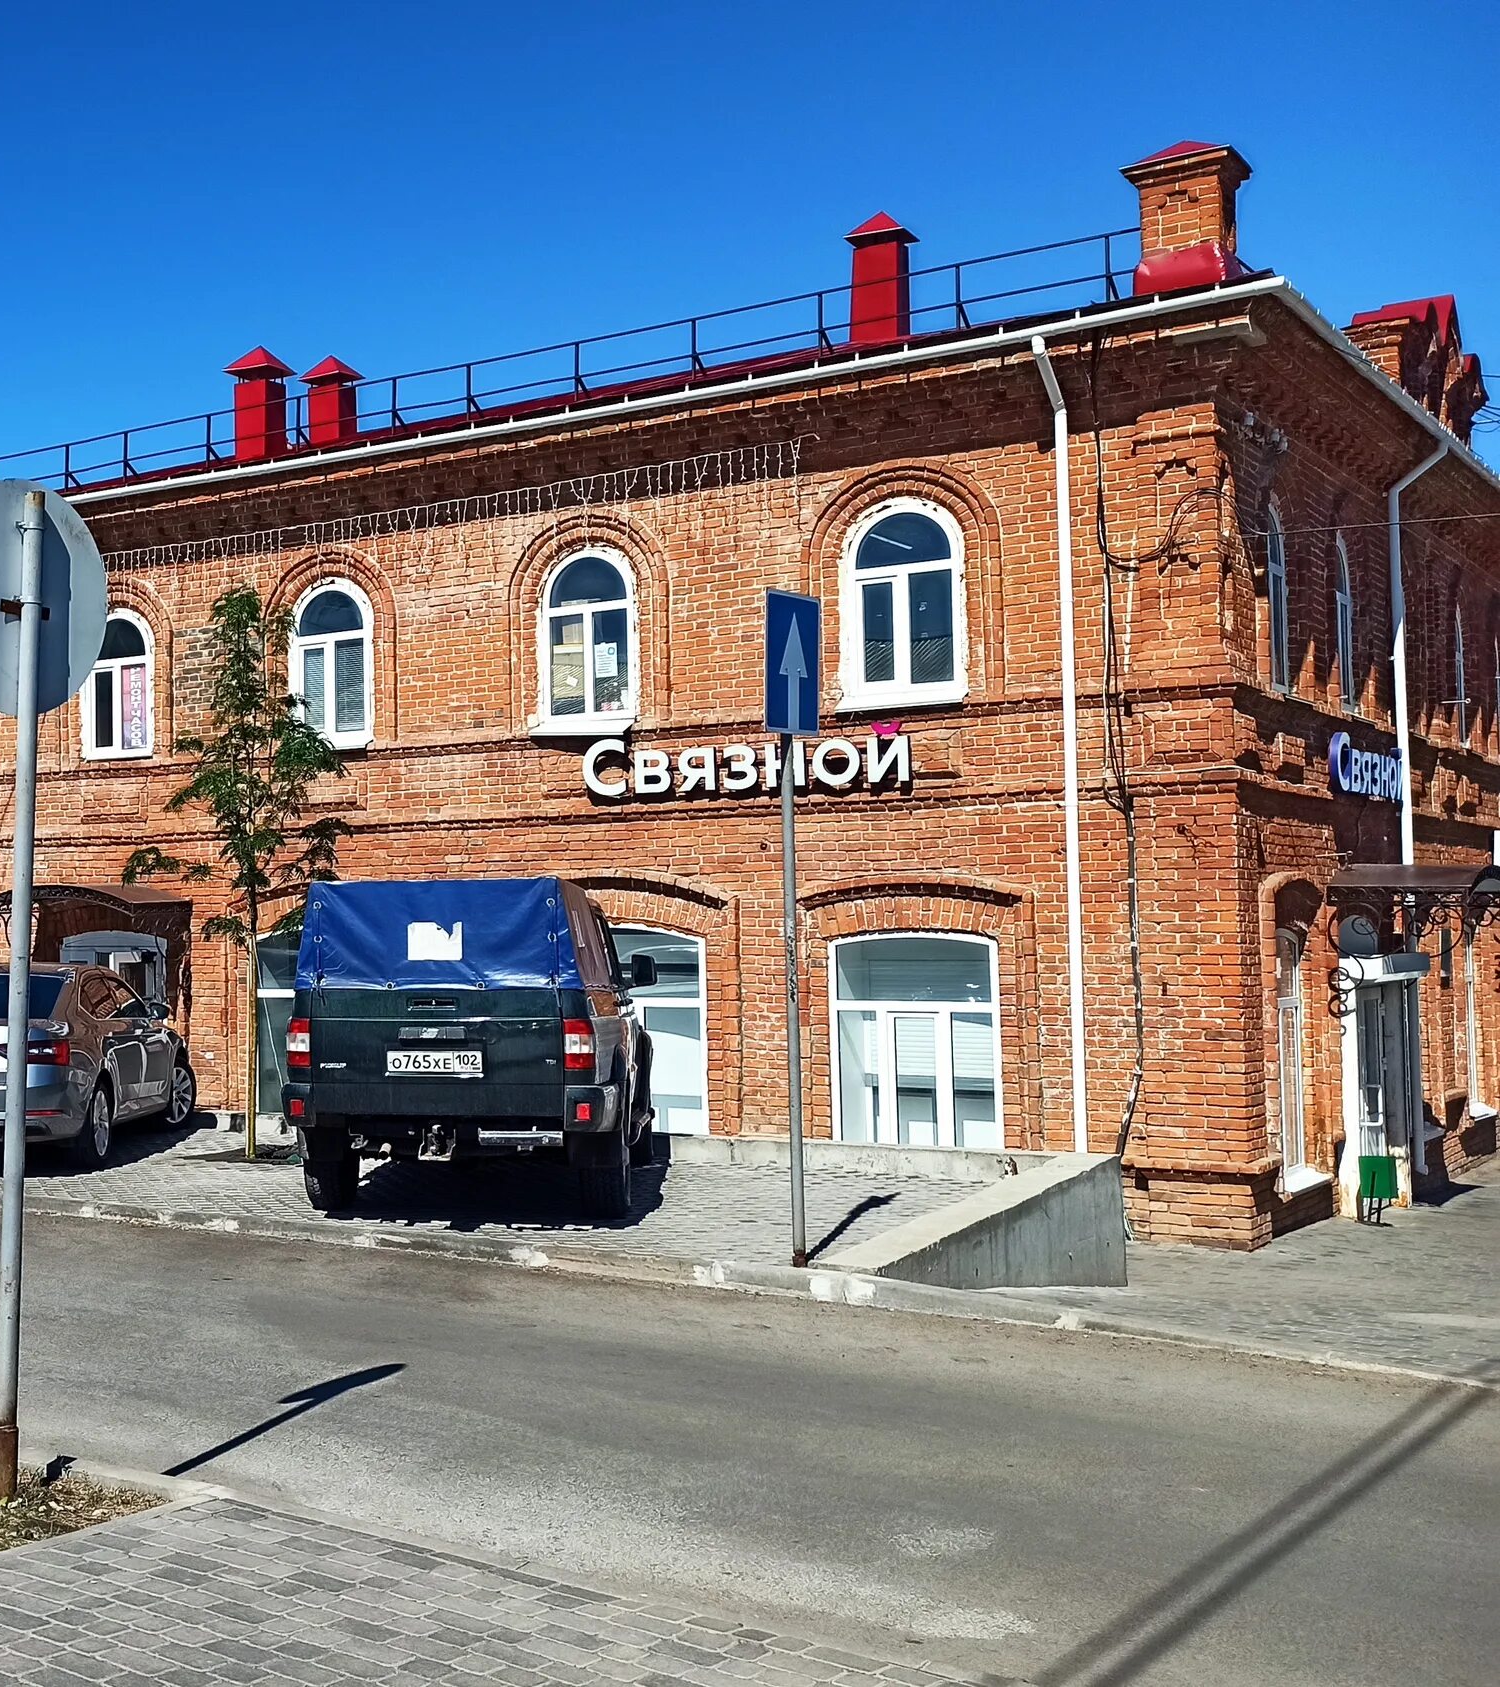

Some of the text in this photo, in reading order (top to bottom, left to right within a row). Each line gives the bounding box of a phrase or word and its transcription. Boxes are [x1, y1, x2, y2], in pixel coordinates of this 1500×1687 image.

[130, 709, 143, 746] ЧАСОВ
[582, 720, 913, 797] Связной
[455, 1054, 478, 1066] 102
